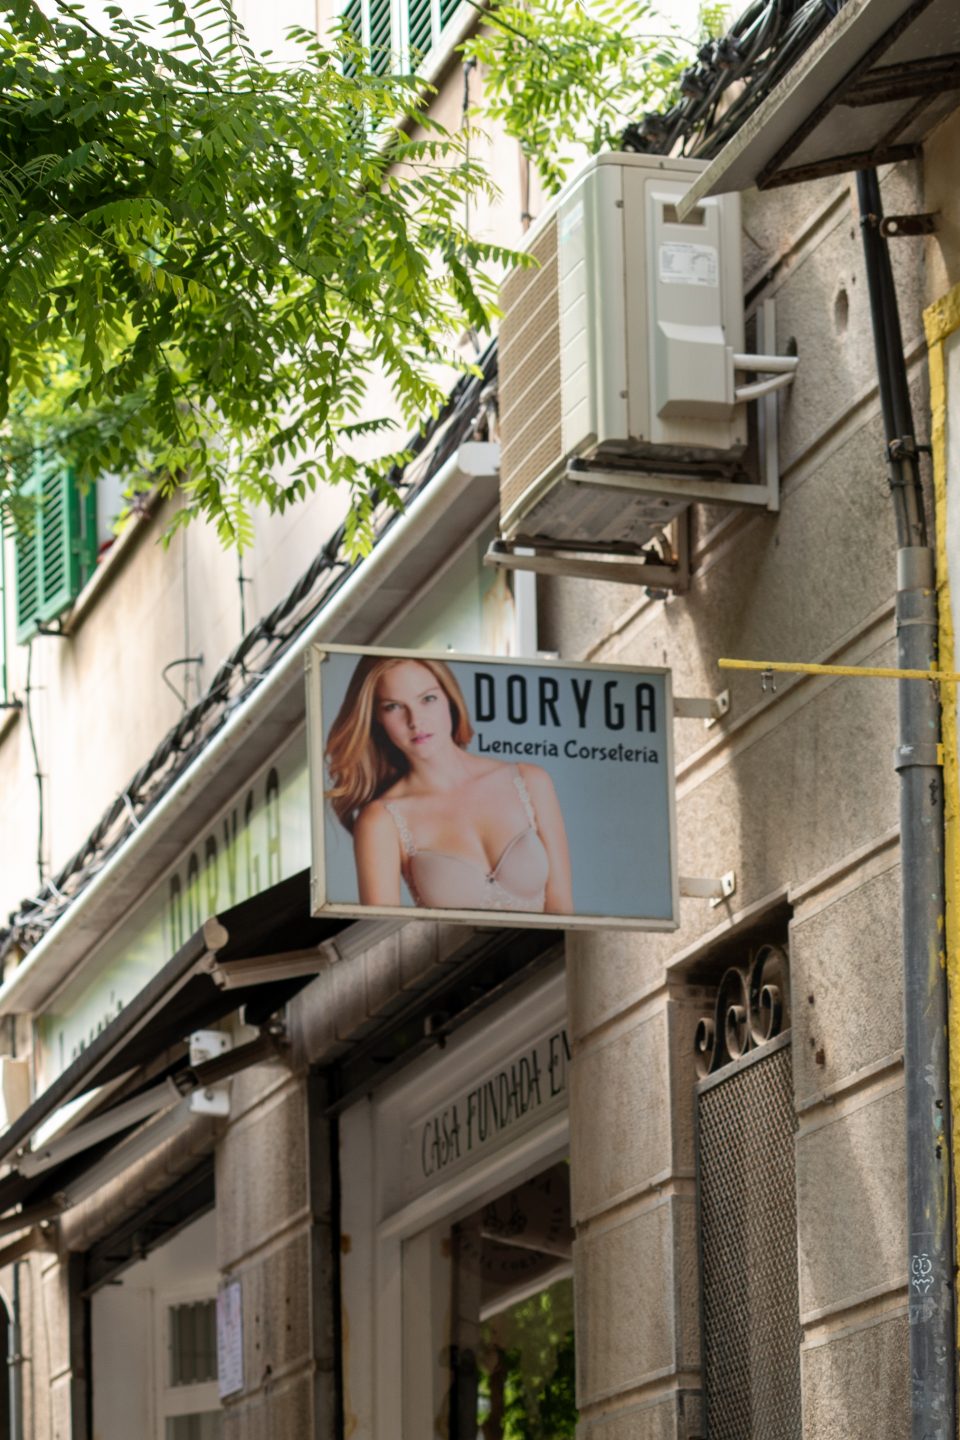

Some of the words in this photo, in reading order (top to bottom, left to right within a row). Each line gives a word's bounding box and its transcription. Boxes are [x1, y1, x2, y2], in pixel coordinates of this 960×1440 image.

[474, 672, 657, 733] DORYGA
[421, 1104, 461, 1178] CASA
[466, 1050, 542, 1151] FUNDADA
